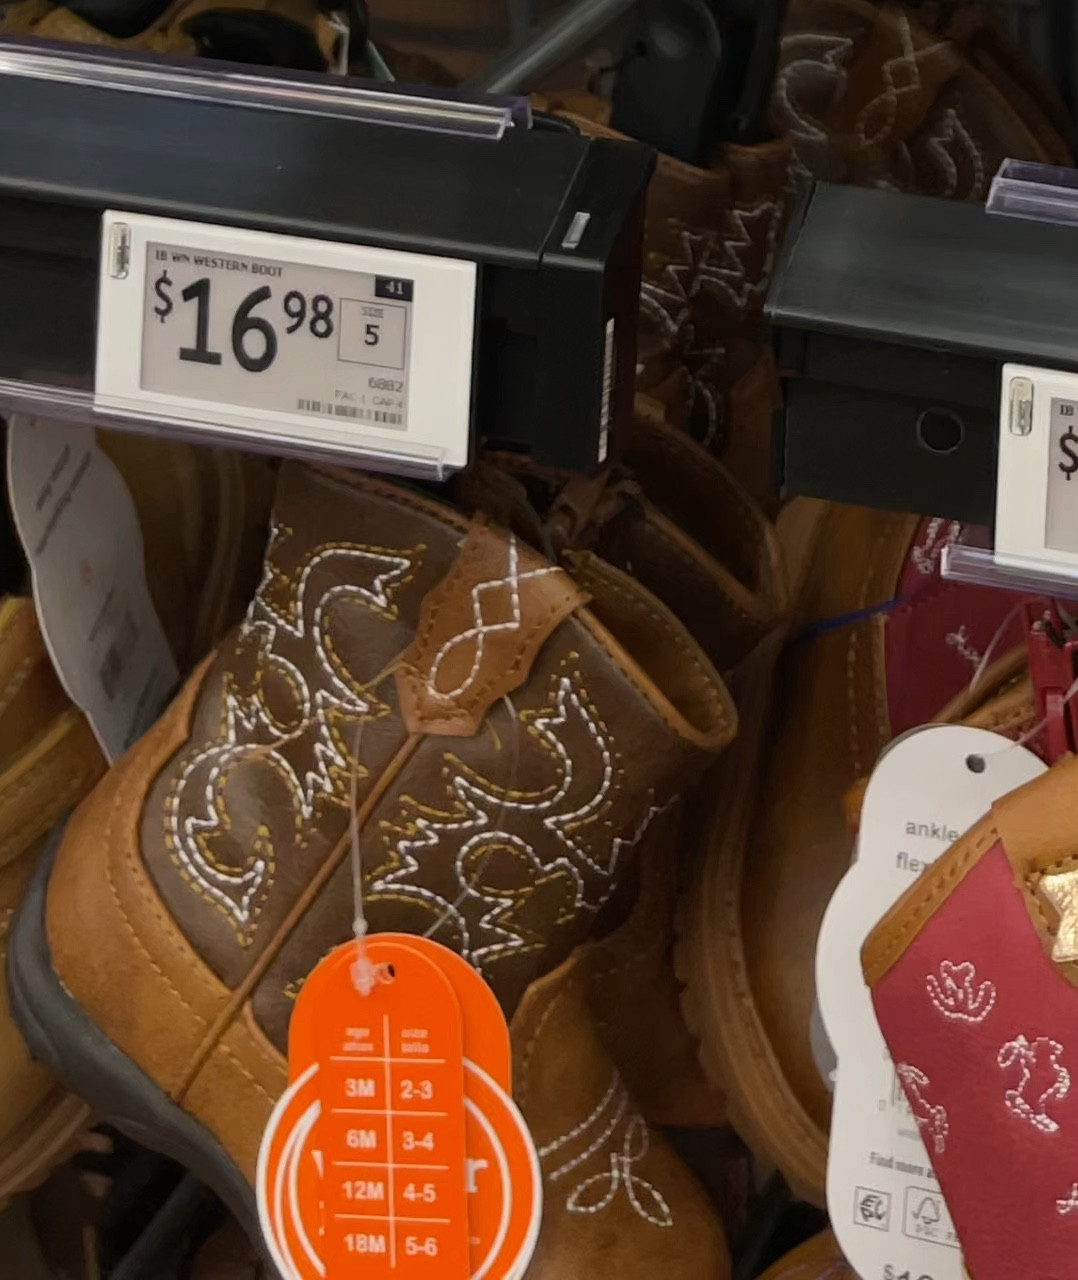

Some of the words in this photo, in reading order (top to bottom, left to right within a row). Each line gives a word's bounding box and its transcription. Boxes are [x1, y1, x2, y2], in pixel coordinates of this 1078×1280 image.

[193, 255, 249, 275] WESTERN
[251, 262, 284, 279] BOOT
[364, 324, 380, 346] 5
[906, 821, 959, 844] ankle
[345, 1078, 375, 1098] 3M
[400, 1079, 433, 1100] 2-3
[346, 1130, 377, 1149] 6M
[402, 1131, 435, 1151] 3-4
[342, 1180, 385, 1200] 12M
[403, 1183, 437, 1203] 4-5
[343, 1233, 387, 1255] 18M
[405, 1235, 438, 1256] 5-6
